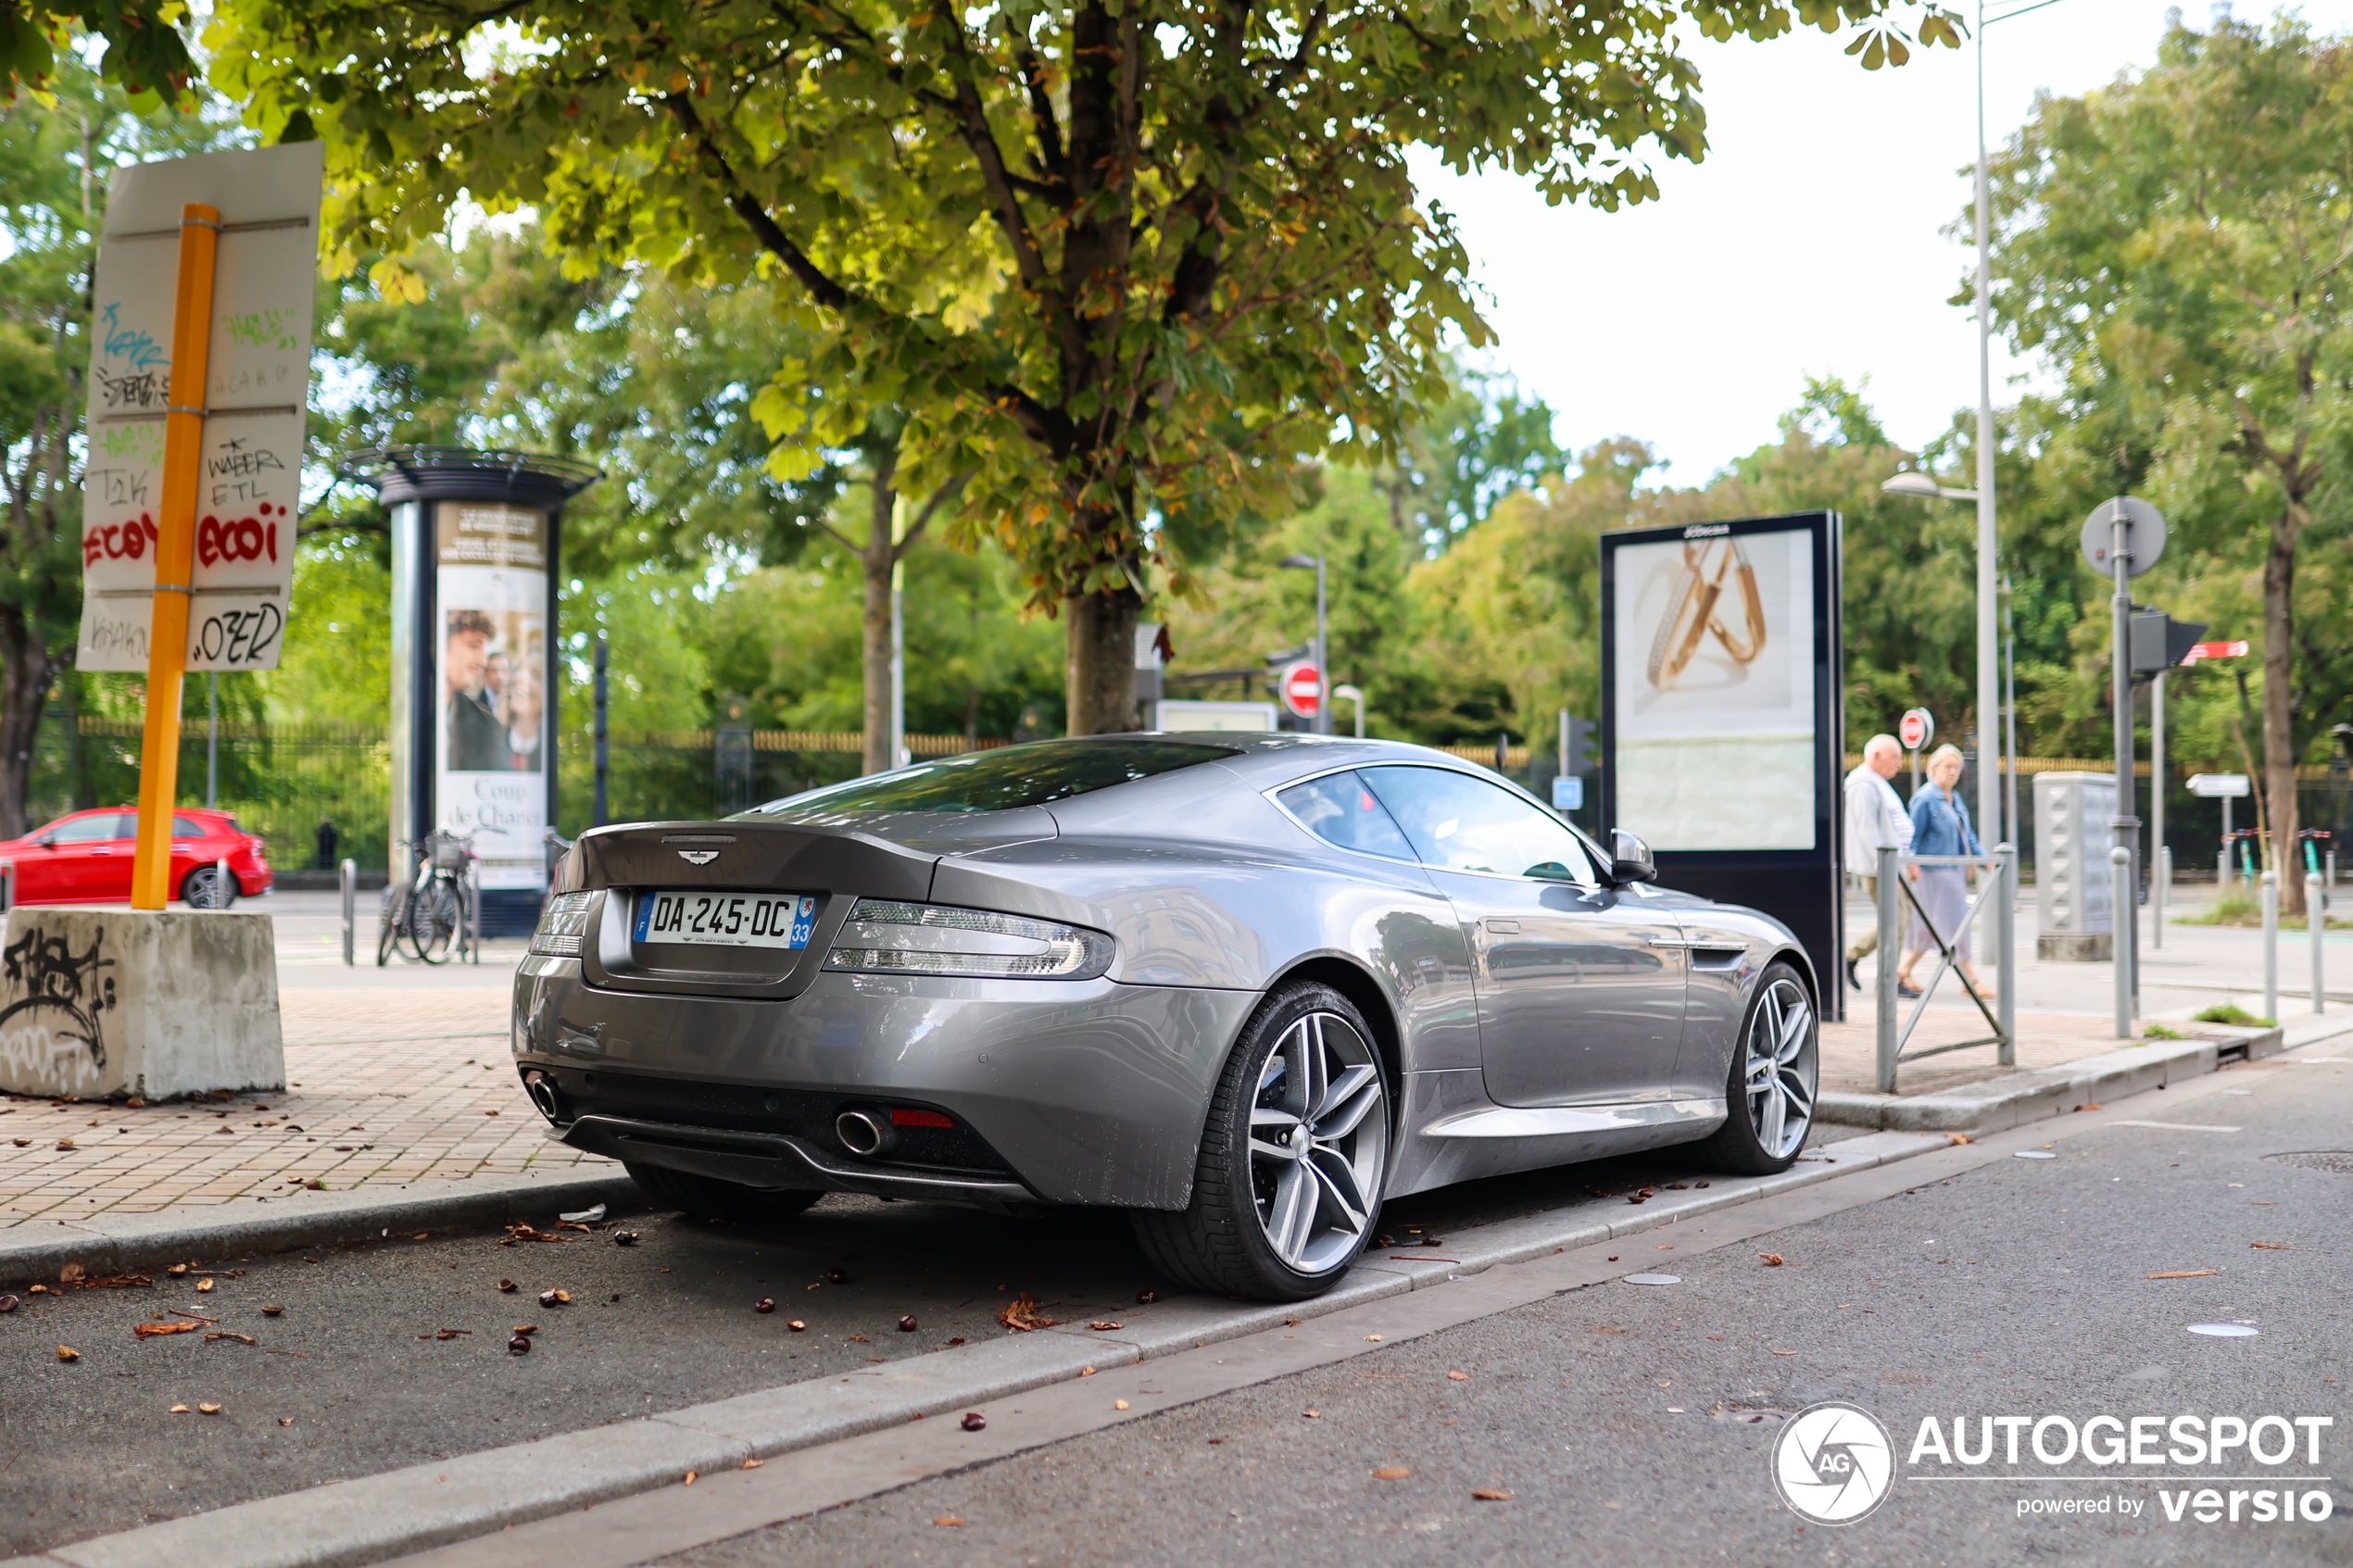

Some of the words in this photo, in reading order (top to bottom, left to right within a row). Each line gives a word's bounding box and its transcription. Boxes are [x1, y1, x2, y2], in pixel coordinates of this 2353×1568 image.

[210, 480, 269, 507] ETL
[475, 775, 526, 804] Coup
[449, 802, 471, 827] de
[638, 921, 646, 932] F
[792, 923, 810, 942] 33
